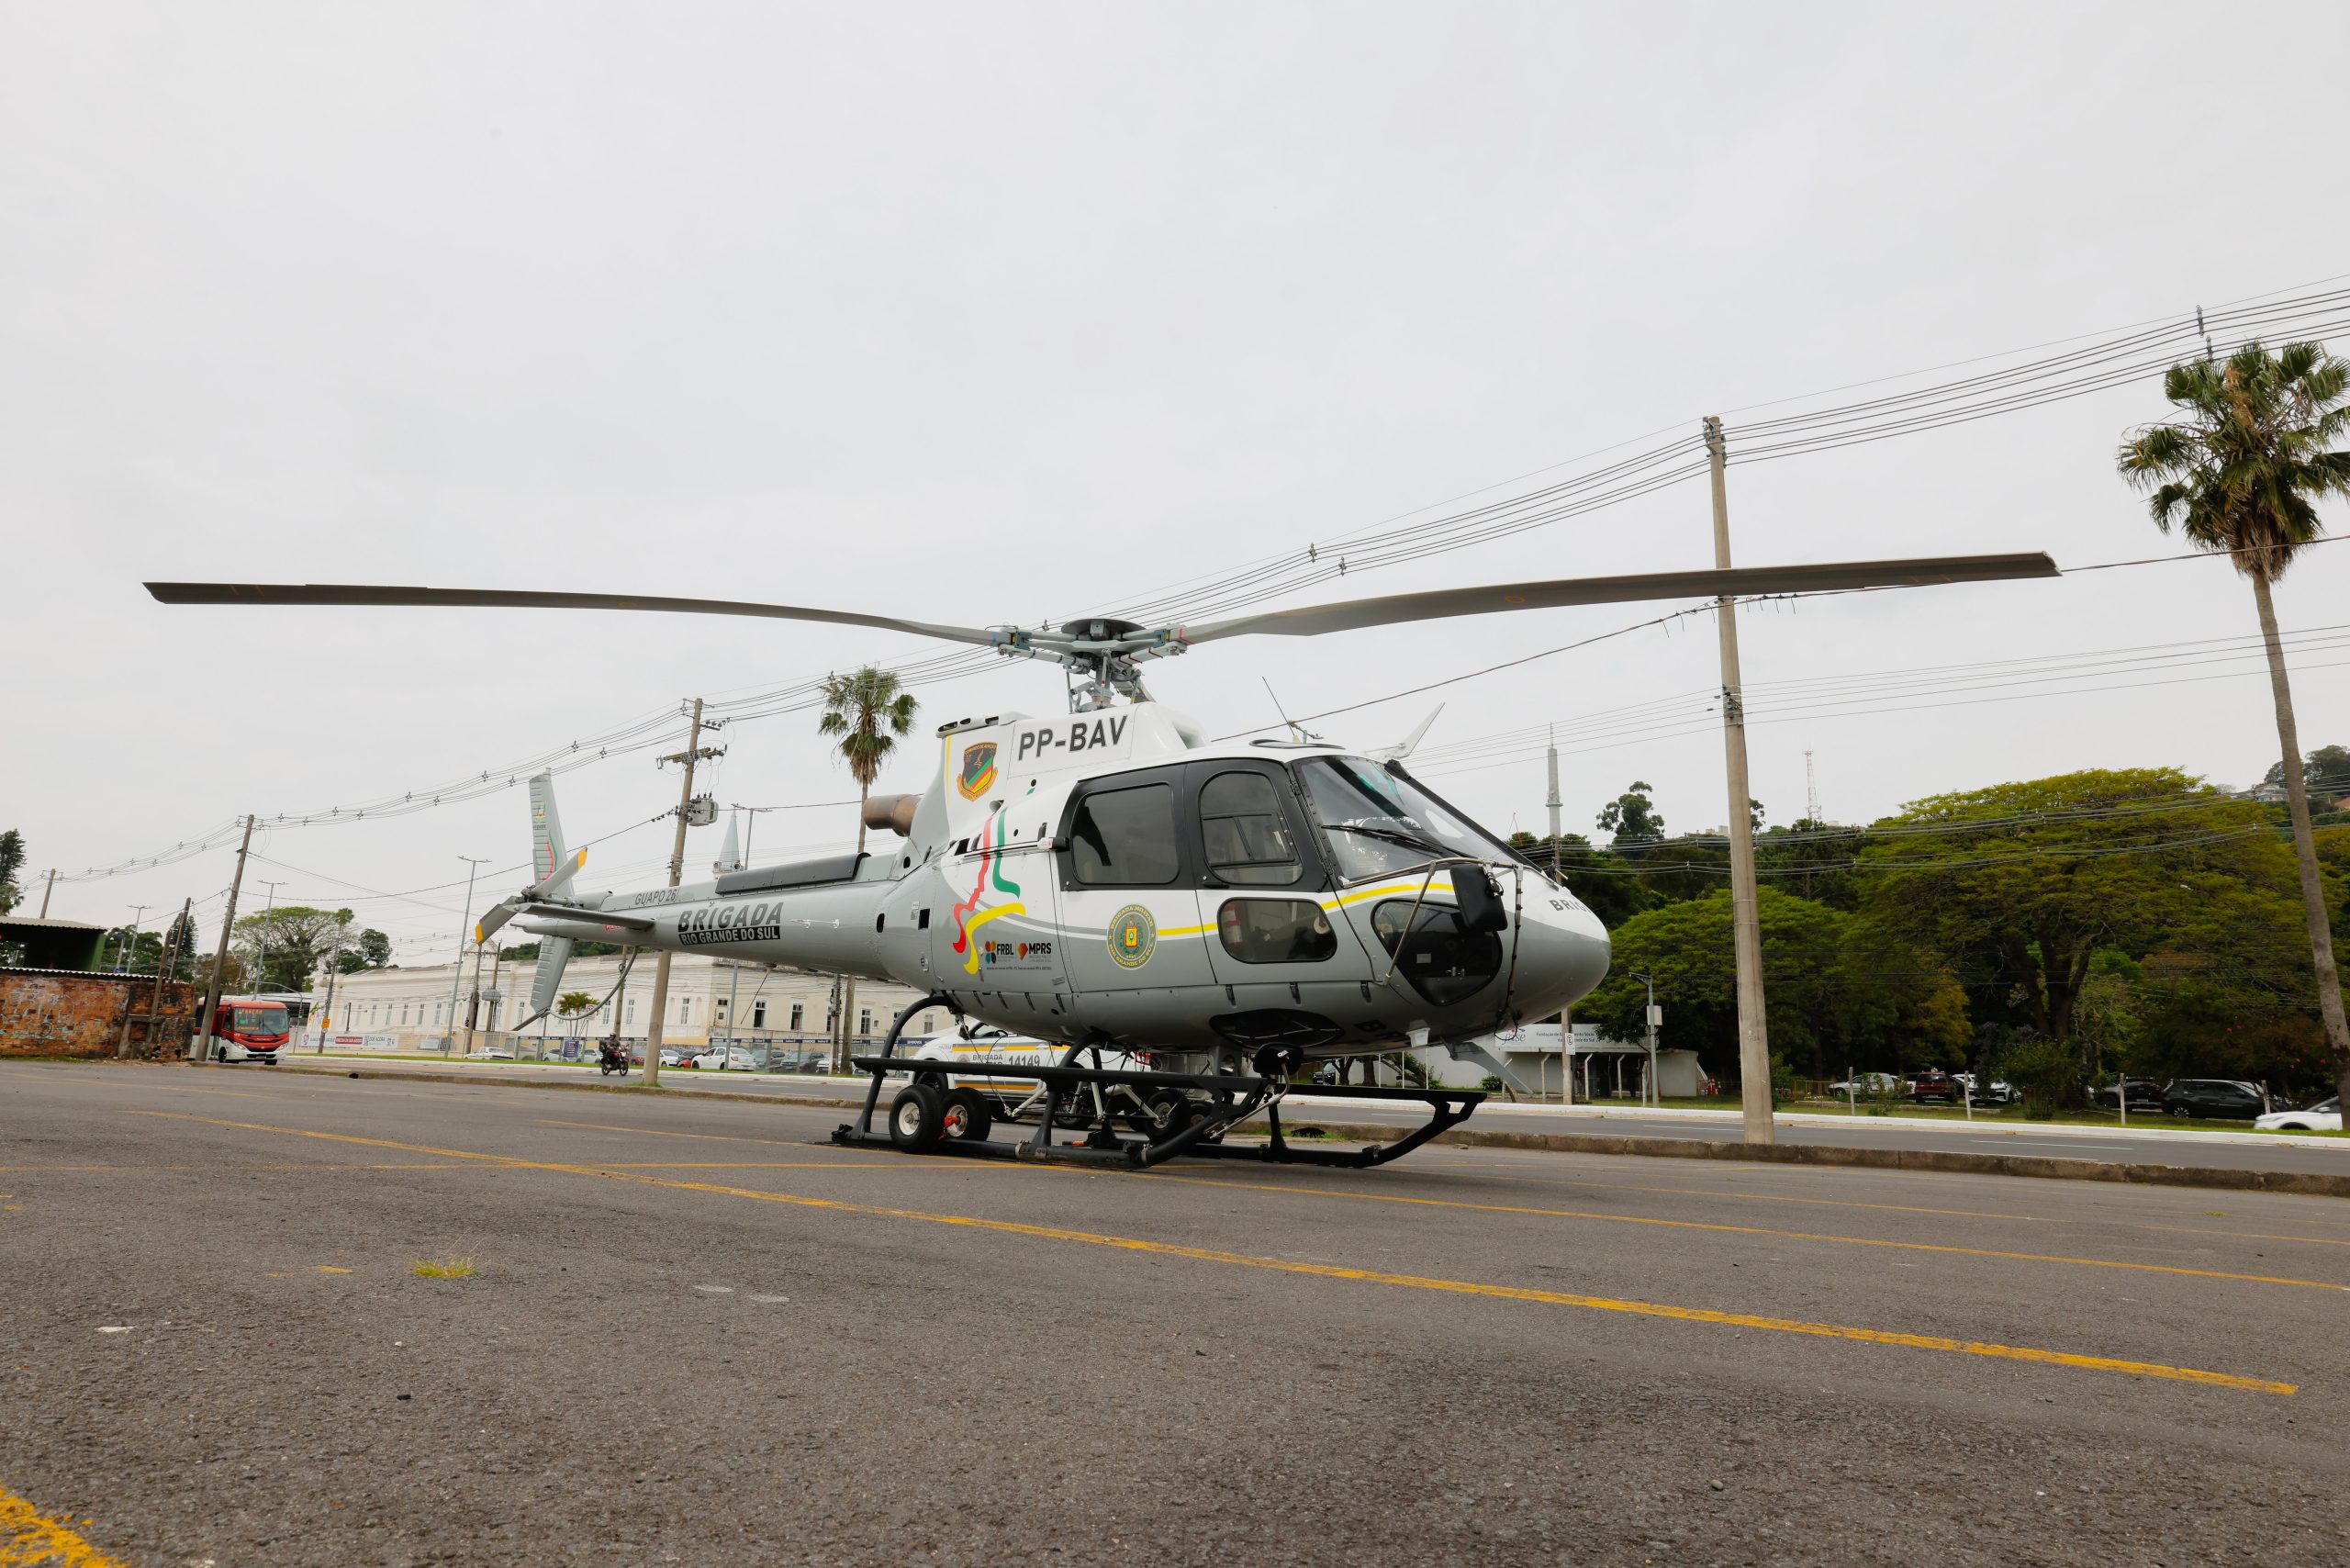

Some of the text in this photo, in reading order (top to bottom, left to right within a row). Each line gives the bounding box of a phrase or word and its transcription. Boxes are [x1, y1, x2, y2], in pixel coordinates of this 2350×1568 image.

[1018, 714, 1128, 761] PP-BAV
[635, 889, 677, 905] GUAPO 26
[678, 902, 784, 932] BRIGADA
[681, 926, 778, 945] RIO GRANDE DO SUL
[997, 944, 1013, 955] FRBL
[1029, 943, 1051, 954] MPRS
[1502, 1032, 1527, 1045] fase
[1008, 1055, 1040, 1067] 14149
